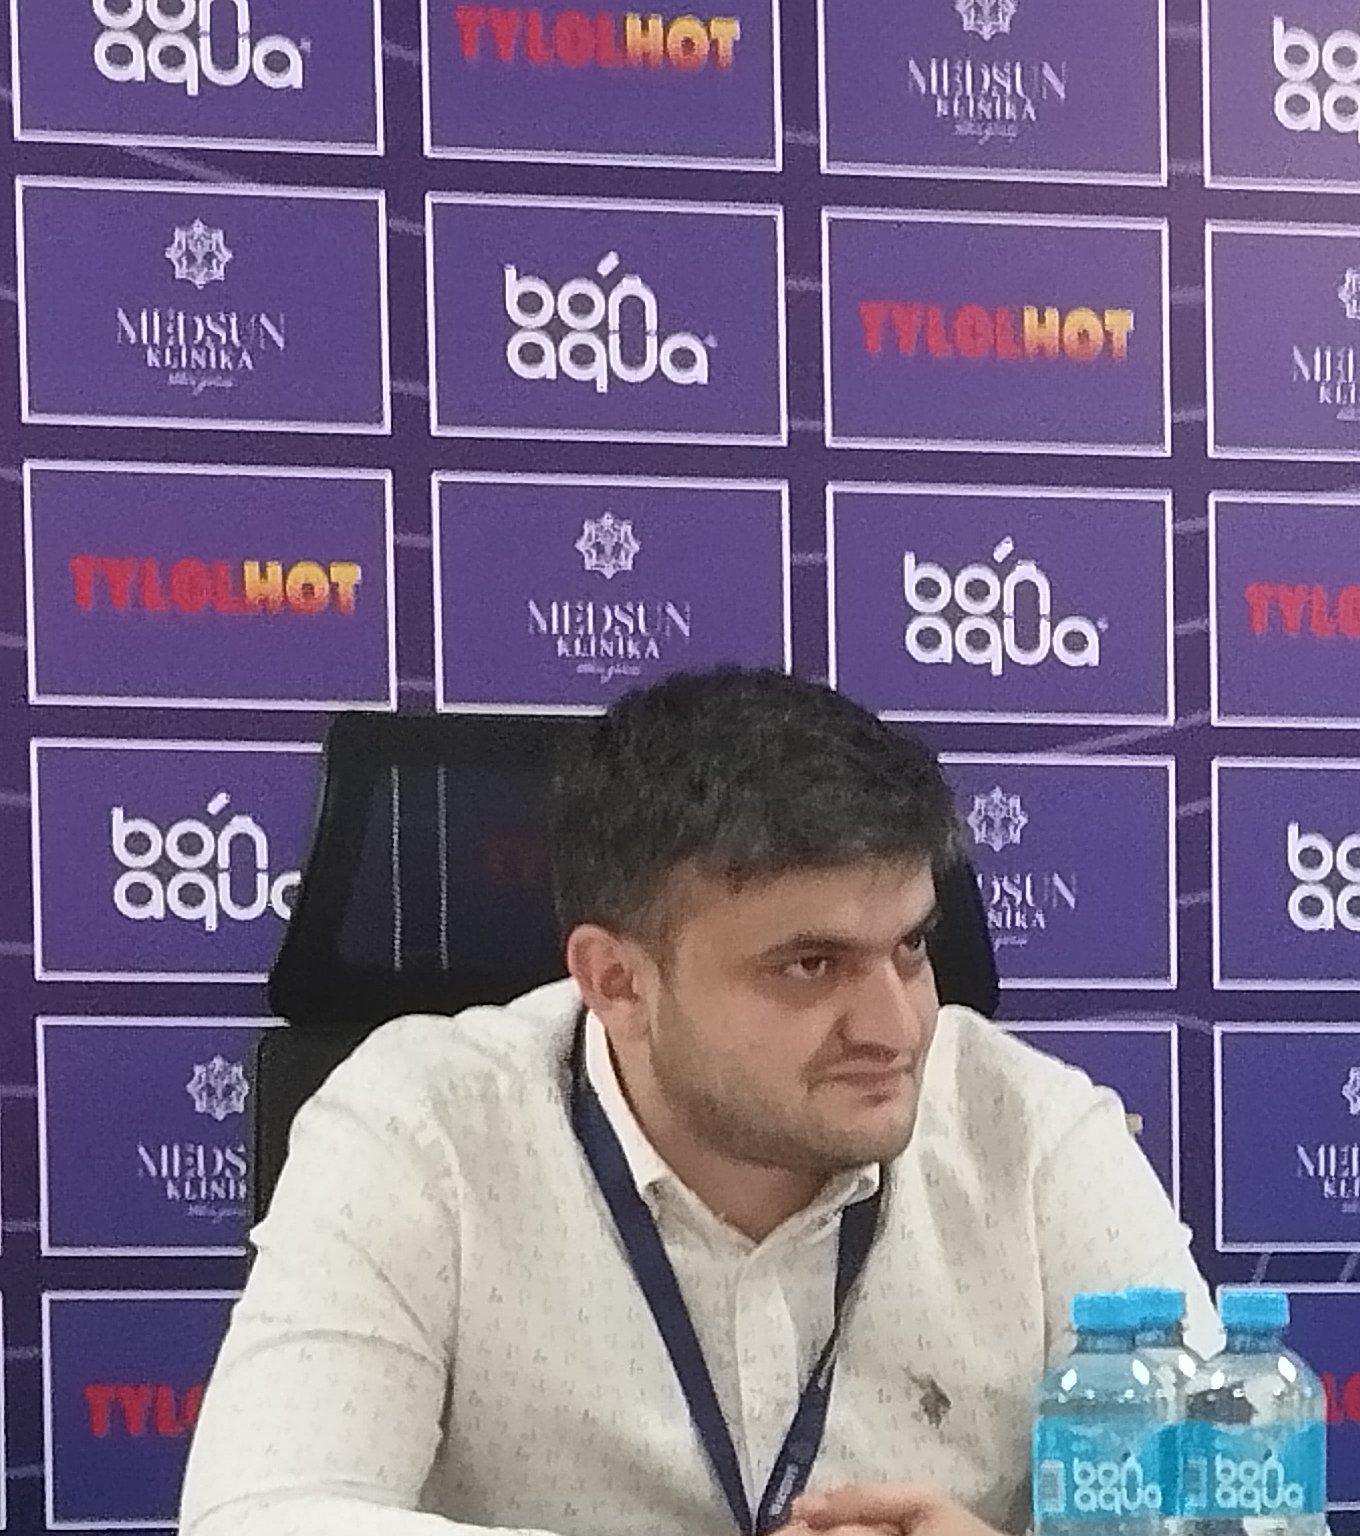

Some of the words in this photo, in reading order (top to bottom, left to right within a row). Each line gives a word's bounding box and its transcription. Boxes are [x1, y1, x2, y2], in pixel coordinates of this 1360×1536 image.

[94, 30, 305, 96] aqua
[505, 251, 657, 331] bón
[507, 329, 711, 393] aqua
[904, 537, 1050, 615] bón
[528, 599, 692, 641] MEDSUN
[556, 635, 660, 660] KLINIKA
[905, 613, 1102, 676] aqua
[111, 792, 268, 870] bón
[137, 1142, 248, 1178] MEDS
[1074, 1483, 1162, 1516] aqua
[1215, 1482, 1304, 1515] aqua
